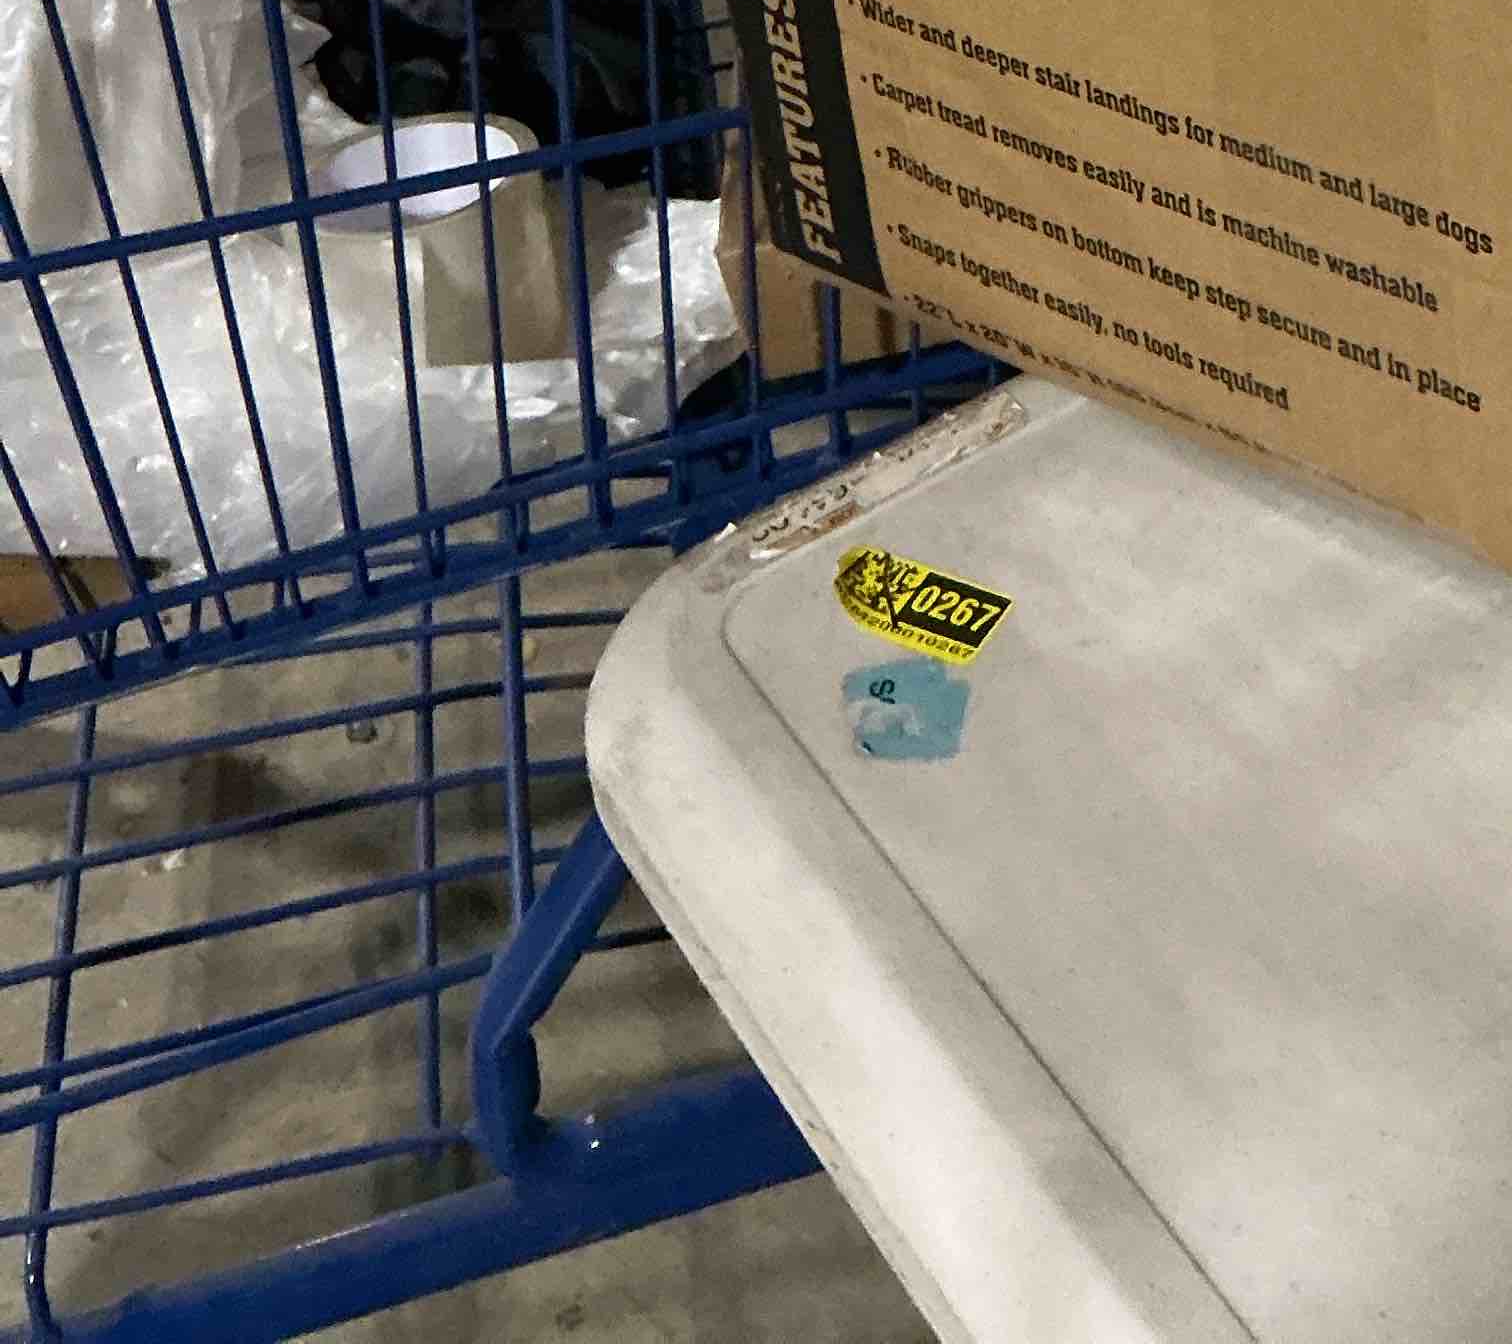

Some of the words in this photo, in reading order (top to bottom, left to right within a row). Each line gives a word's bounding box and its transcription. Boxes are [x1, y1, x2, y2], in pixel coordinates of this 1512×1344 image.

[872, 74, 935, 119] Carpet
[938, 101, 987, 138] tread
[992, 126, 1079, 174] removes
[1083, 160, 1146, 205] easily
[1151, 185, 1191, 219] and
[1196, 199, 1218, 228] is
[1222, 216, 1320, 267] machine
[1324, 251, 1440, 314] washable
[919, 19, 957, 53] and
[962, 35, 1029, 78] deeper
[1035, 62, 1081, 99] stair
[1085, 80, 1180, 136] landings
[1185, 115, 1215, 147] for
[1218, 132, 1314, 185] medium
[1319, 168, 1363, 204] and
[1369, 184, 1430, 229] large
[1436, 212, 1494, 255] dogs
[887, 147, 954, 197] Rubber
[957, 181, 1037, 233] grippers
[1041, 218, 1069, 244] on
[1071, 227, 1145, 276] bottom
[1147, 256, 1201, 302] keep
[1204, 283, 1252, 323] step
[1256, 303, 1333, 352] secure
[1337, 335, 1382, 372] and
[1387, 352, 1412, 384] in
[1416, 367, 1482, 413] place
[898, 223, 956, 269] Snaps
[960, 250, 1039, 305] together
[1113, 321, 1139, 346] no
[1143, 329, 1194, 371] tools
[1198, 357, 1291, 412] required
[911, 584, 1001, 633] 0267
